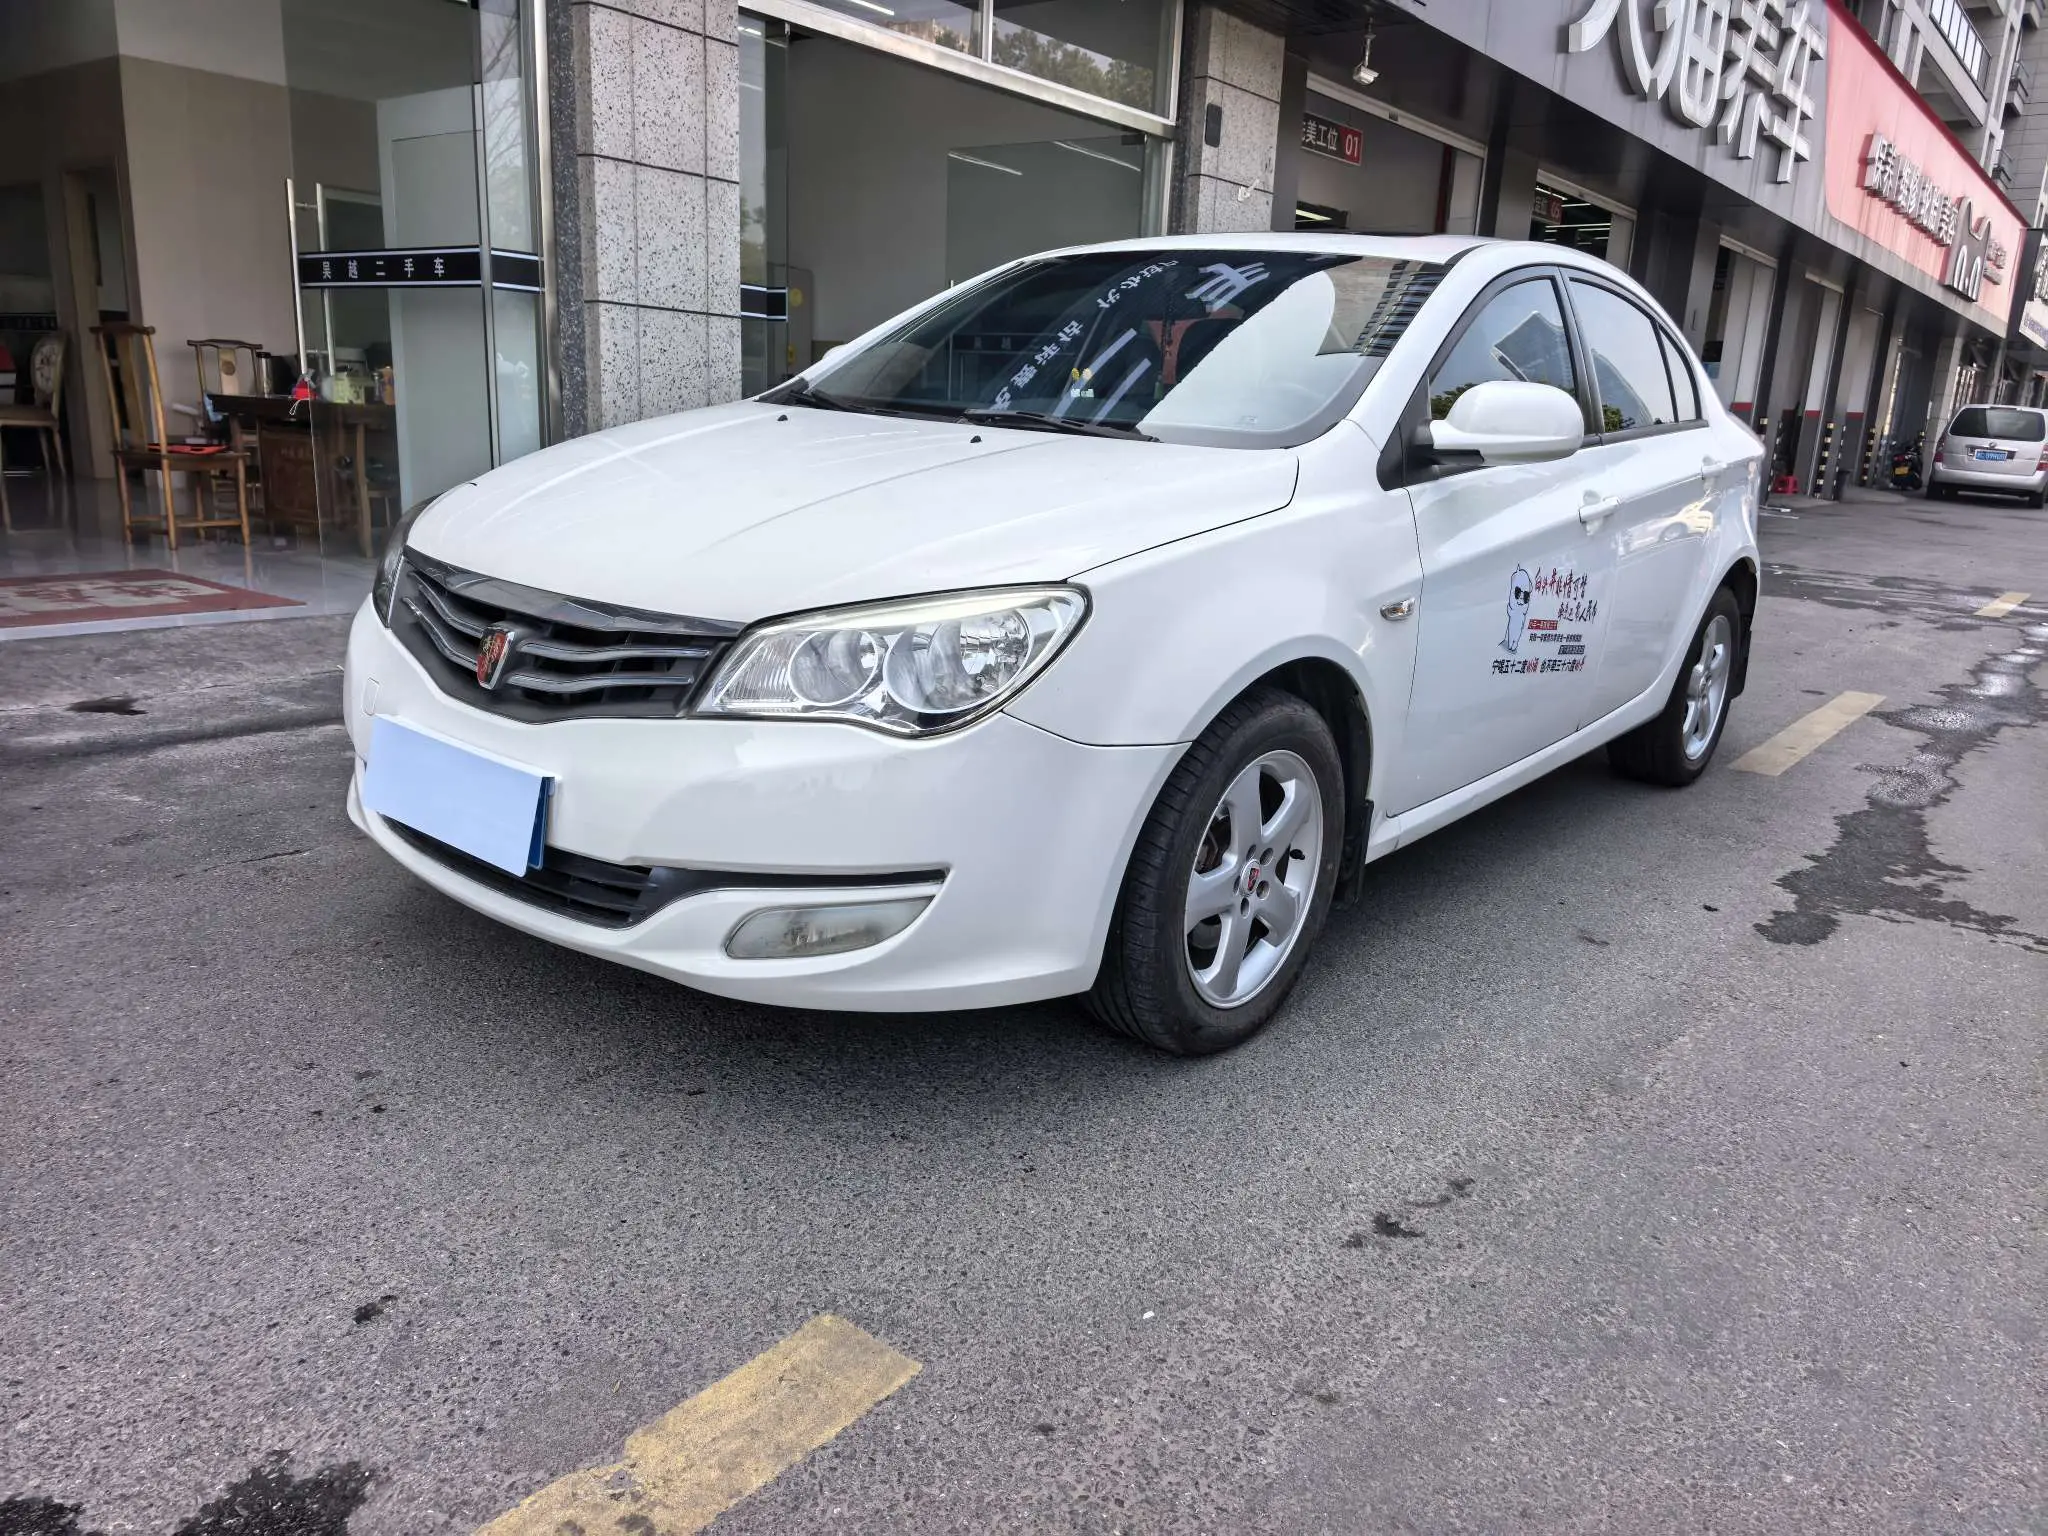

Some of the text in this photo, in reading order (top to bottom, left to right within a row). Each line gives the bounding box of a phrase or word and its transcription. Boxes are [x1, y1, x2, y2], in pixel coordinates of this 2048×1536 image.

[1301, 119, 1359, 158] 美工位 01
